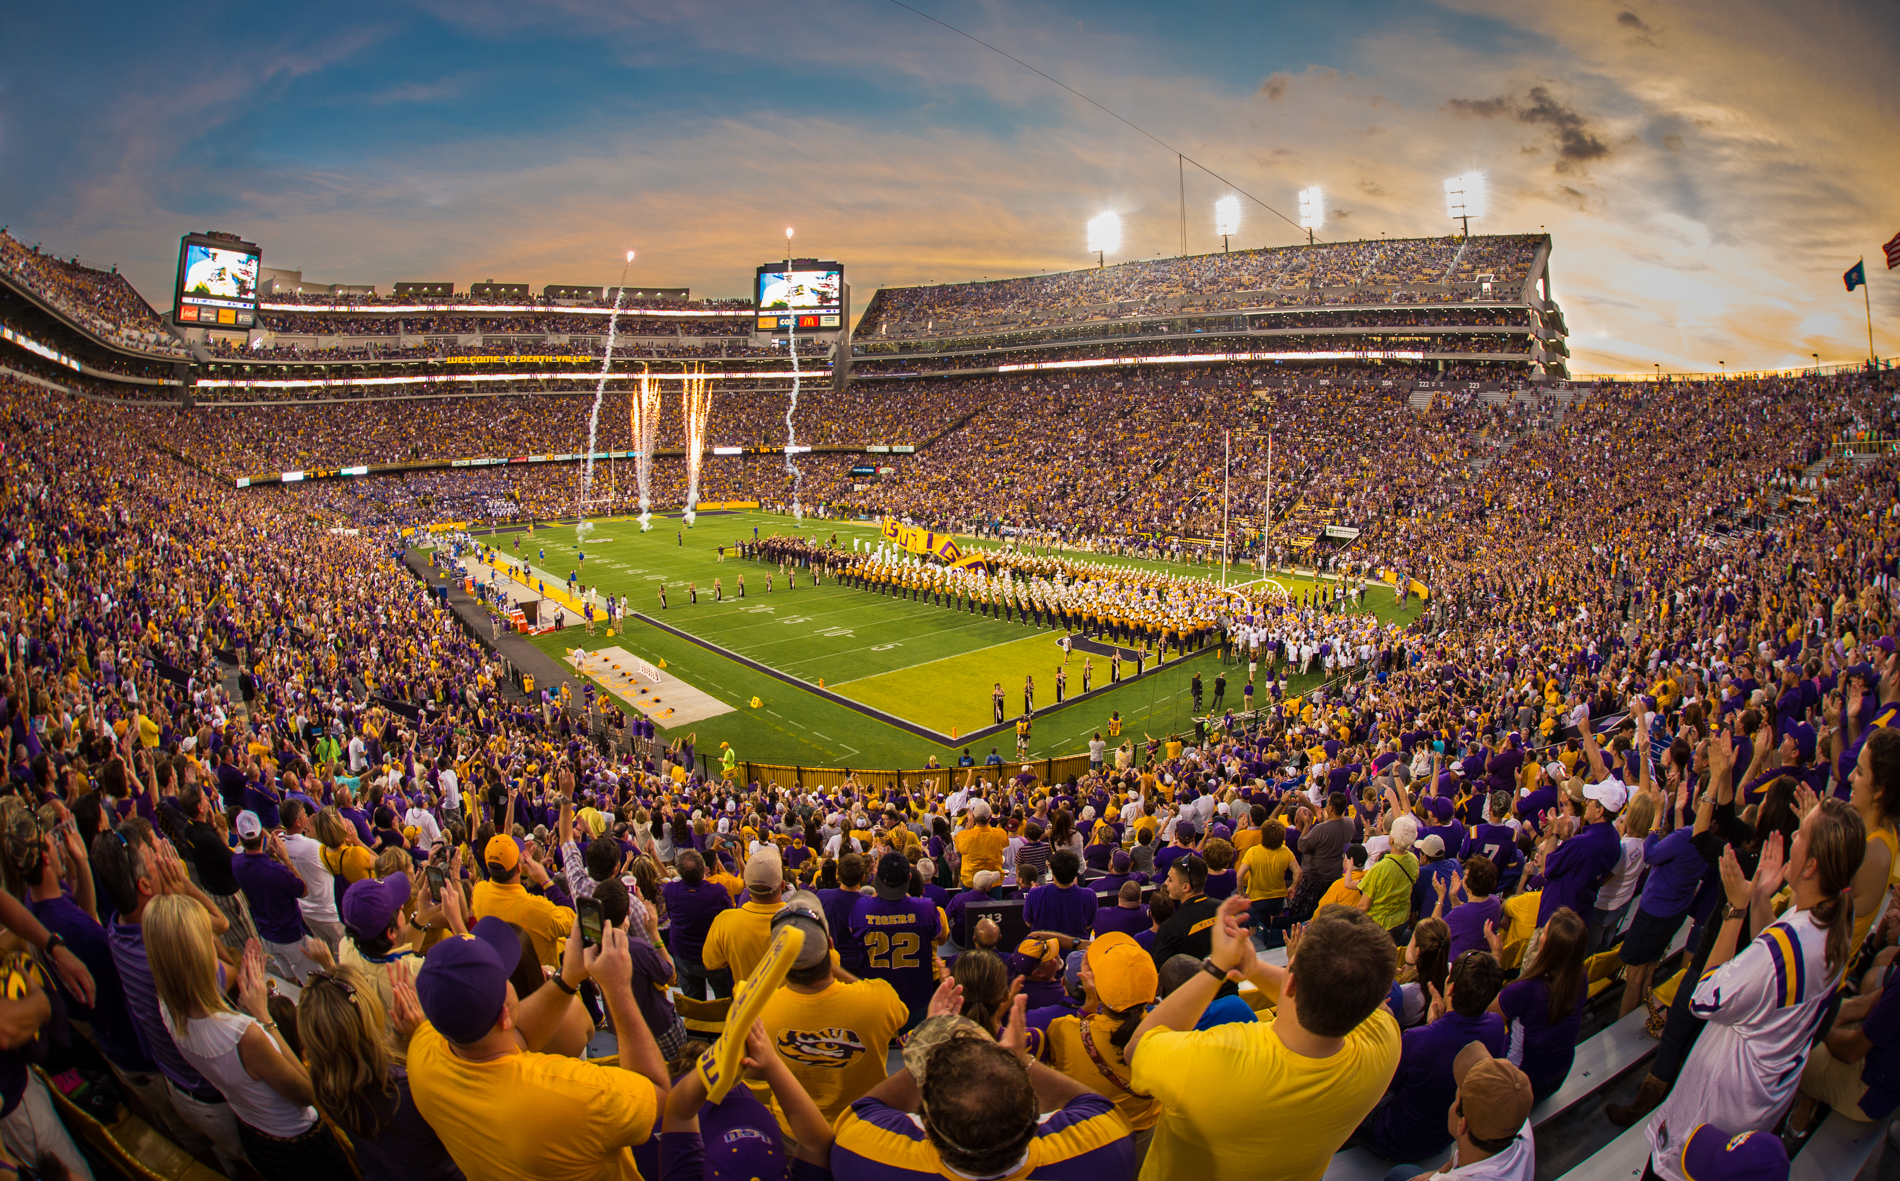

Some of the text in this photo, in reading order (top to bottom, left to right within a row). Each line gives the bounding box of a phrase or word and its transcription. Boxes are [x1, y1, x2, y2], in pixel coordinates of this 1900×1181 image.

[447, 355, 592, 364] WELCOME TO DEATH VALLEY
[775, 614, 813, 624] 15
[814, 626, 854, 636] 10
[870, 643, 903, 651] 5
[1483, 843, 1500, 861] 7
[865, 913, 917, 925] TIGERS
[863, 931, 920, 969] 22
